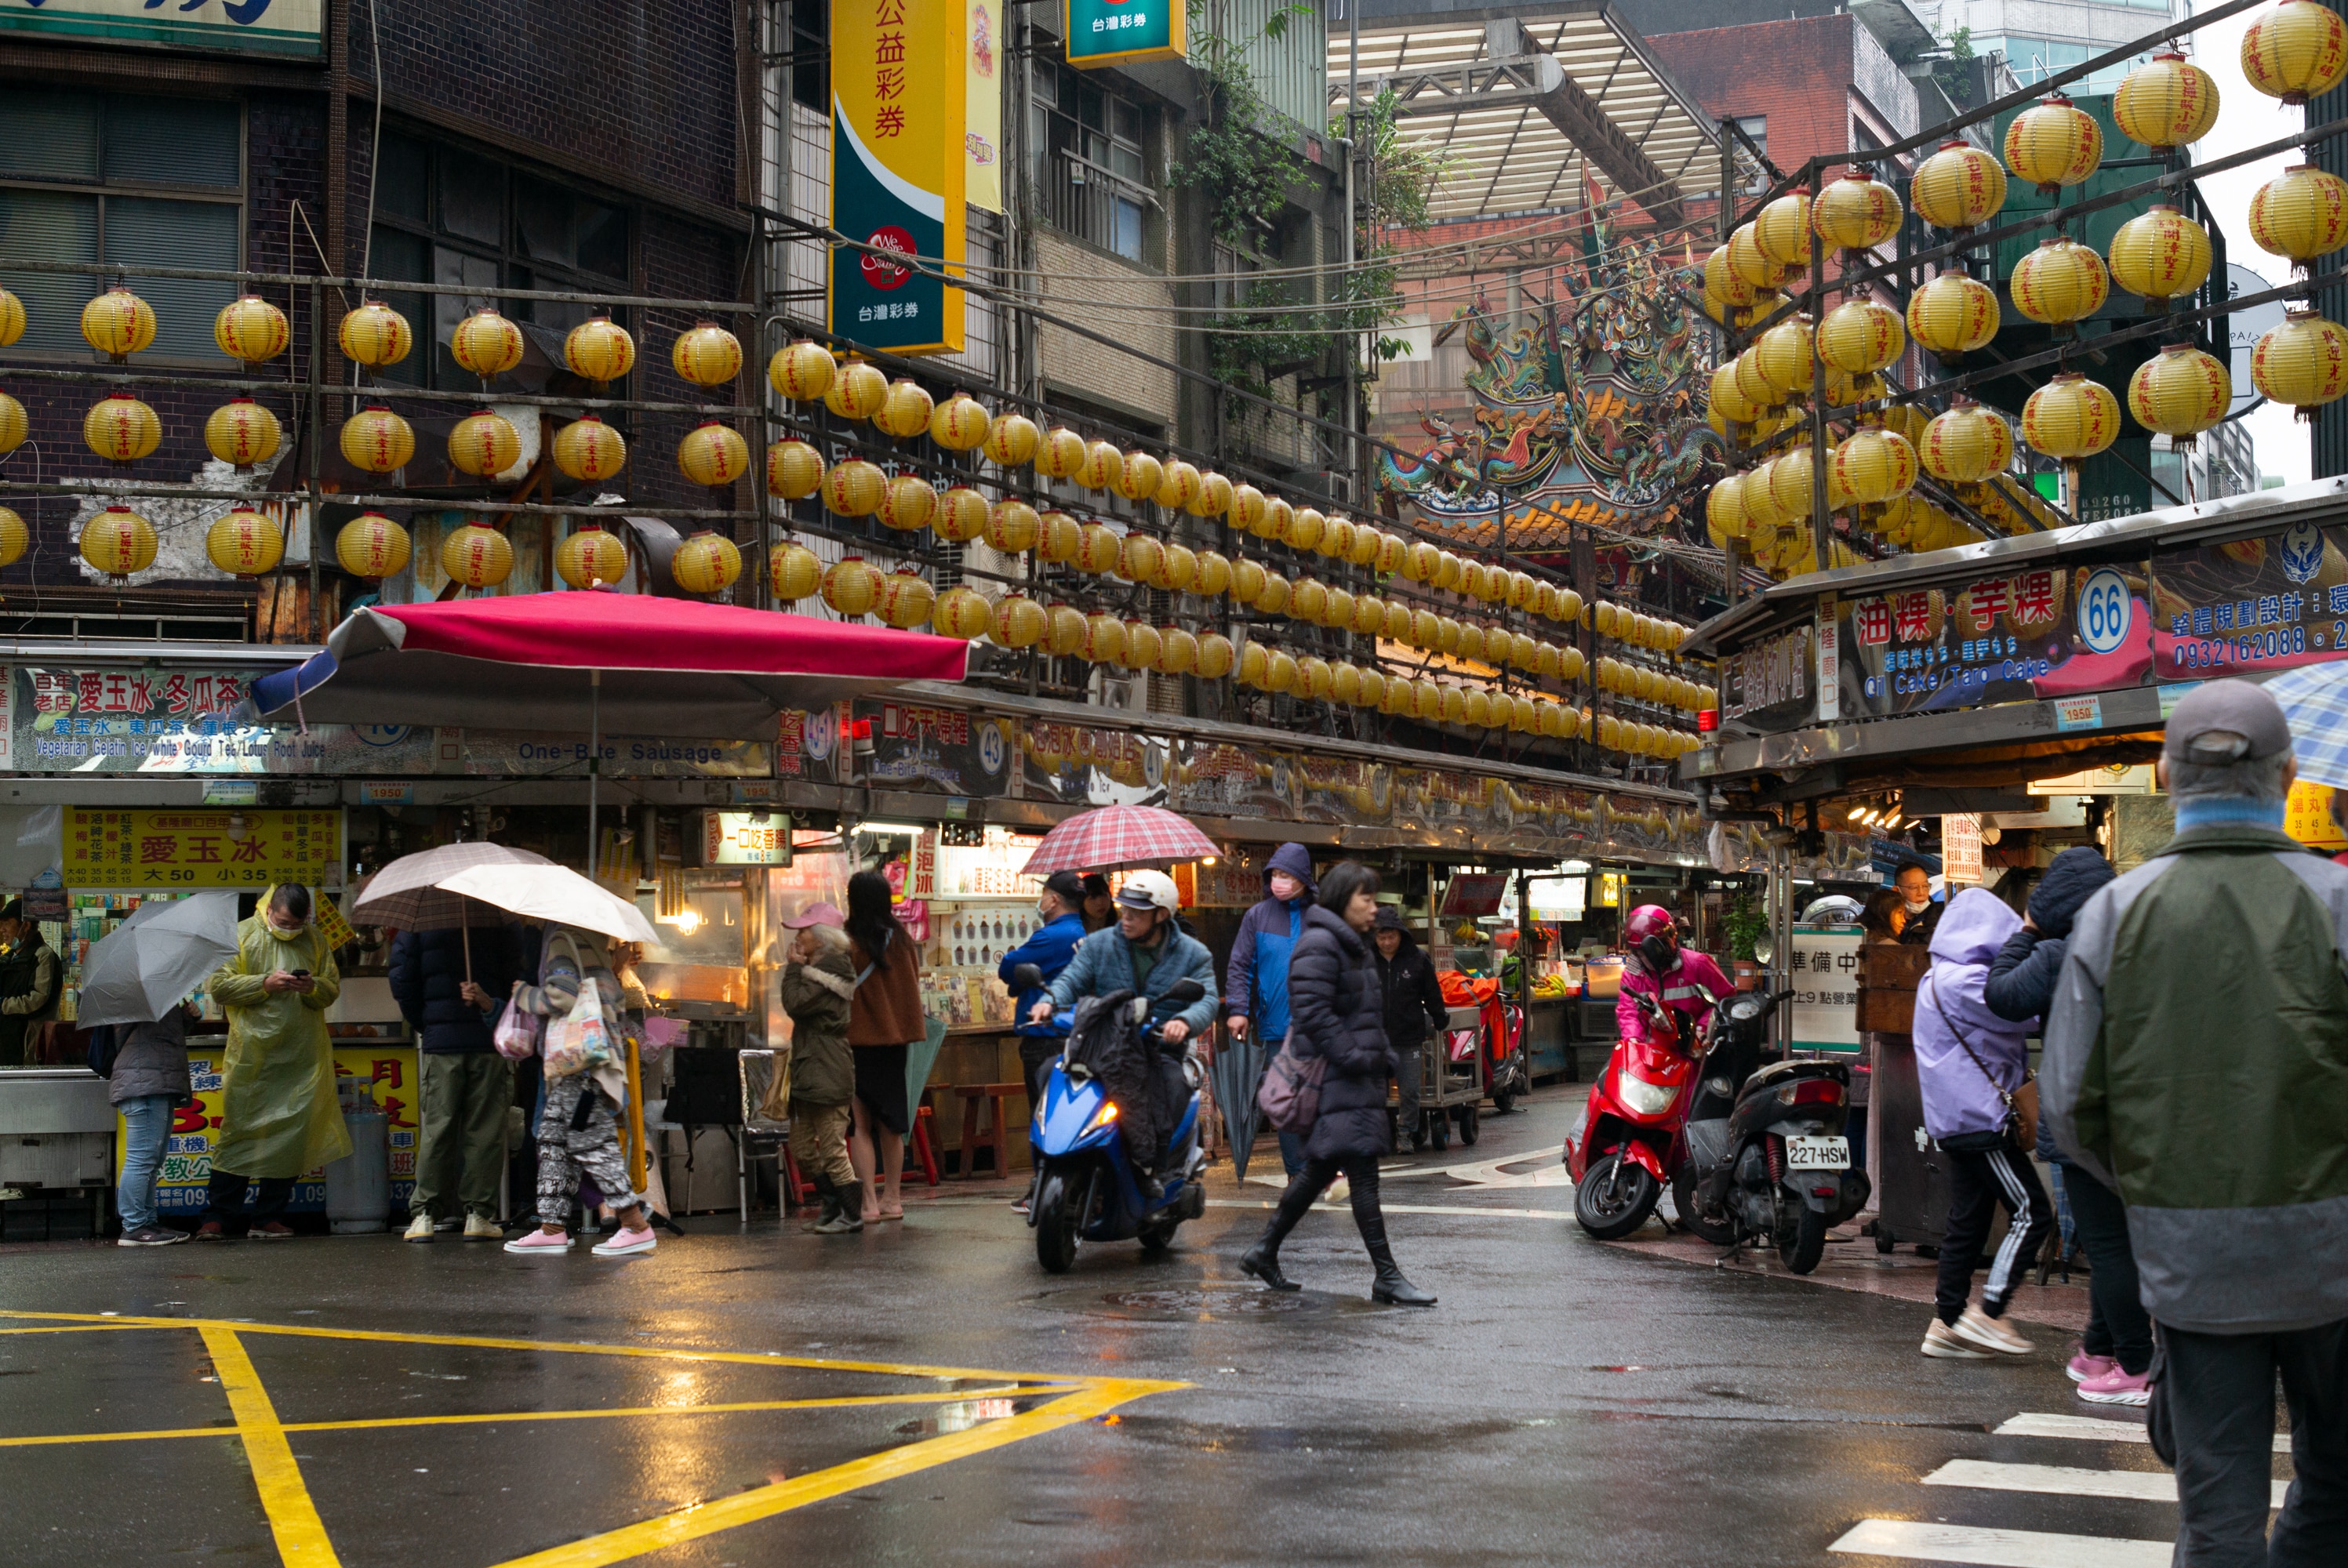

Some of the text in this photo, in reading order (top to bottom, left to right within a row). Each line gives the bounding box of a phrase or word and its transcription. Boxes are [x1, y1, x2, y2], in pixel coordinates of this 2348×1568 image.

[1092, 13, 1147, 32] 台灣彩券
[874, 0, 905, 139] 公益彩券
[966, 134, 995, 162] 刮刮樂
[2162, 230, 2181, 281] 開漳聖王
[859, 302, 918, 322] 台灣彩券
[1857, 570, 2055, 648] 油粿·芋粿
[2088, 583, 2122, 639] 66
[1821, 601, 1836, 704] 基隆廟口
[2174, 626, 2305, 669] 0932162088
[35, 673, 72, 691] 百年
[1865, 675, 1885, 699] Oil
[2001, 657, 2048, 682] Cake
[34, 694, 72, 713] 老店
[2066, 706, 2092, 721] 1950
[36, 737, 87, 759] Vegetarian
[93, 738, 126, 757] Gelatin
[184, 739, 213, 757] Gourd
[274, 741, 296, 758] Root
[301, 740, 325, 758] Juice
[519, 742, 723, 764] One-Bte Sausage
[984, 731, 1000, 764] 43
[373, 789, 402, 798] 1950
[75, 813, 88, 860] 酸梅湯
[157, 817, 253, 828] 基隆廟口百年店
[282, 813, 294, 859] 仙草冰
[311, 813, 323, 859] 冬瓜茶
[2295, 819, 2303, 829] 35
[2311, 818, 2319, 828] 45
[90, 813, 103, 862] 洛神花茶
[140, 835, 268, 864] 愛玉冰
[296, 813, 309, 862] 仙草冬瓜
[726, 828, 786, 850] 一口吃香腸
[144, 868, 267, 880] 大 50 小 35
[914, 829, 936, 894] 泡泡冰
[1792, 950, 1856, 974] 準備中
[1789, 1147, 1849, 1164] 227-HSW
